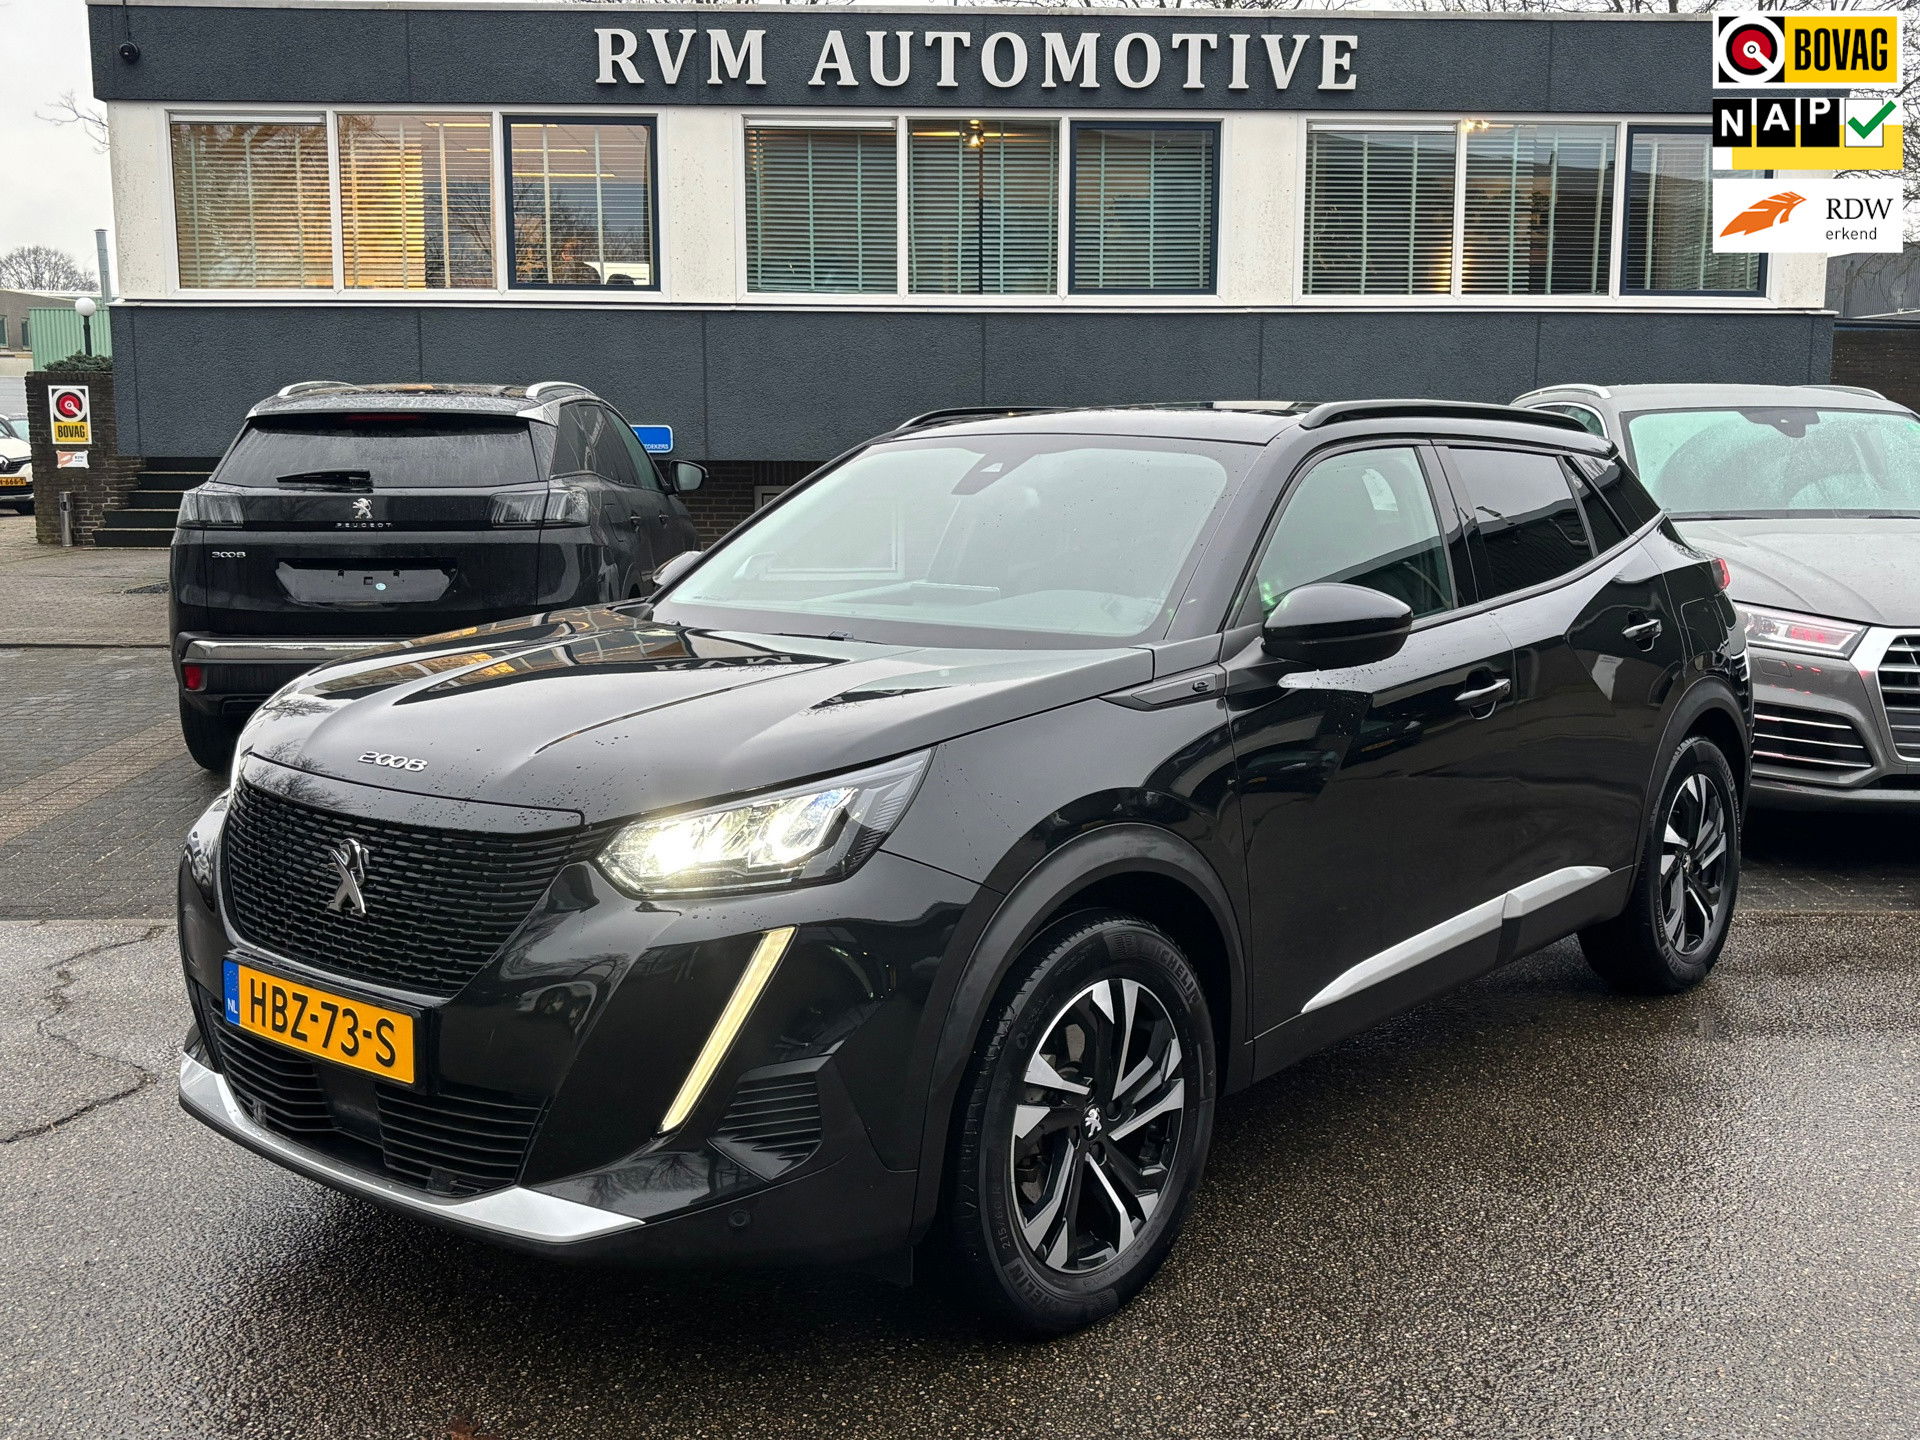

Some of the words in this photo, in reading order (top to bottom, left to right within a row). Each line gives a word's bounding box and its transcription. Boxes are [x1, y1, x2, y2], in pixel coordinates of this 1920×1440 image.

[594, 27, 768, 86] RVM
[808, 29, 1359, 91] AUTOMOTIVE
[57, 425, 86, 438] BOVAG
[211, 551, 247, 559] 3008
[358, 751, 428, 772] 2008
[227, 998, 238, 1014] NL
[250, 978, 396, 1068] HBZ-73-S
